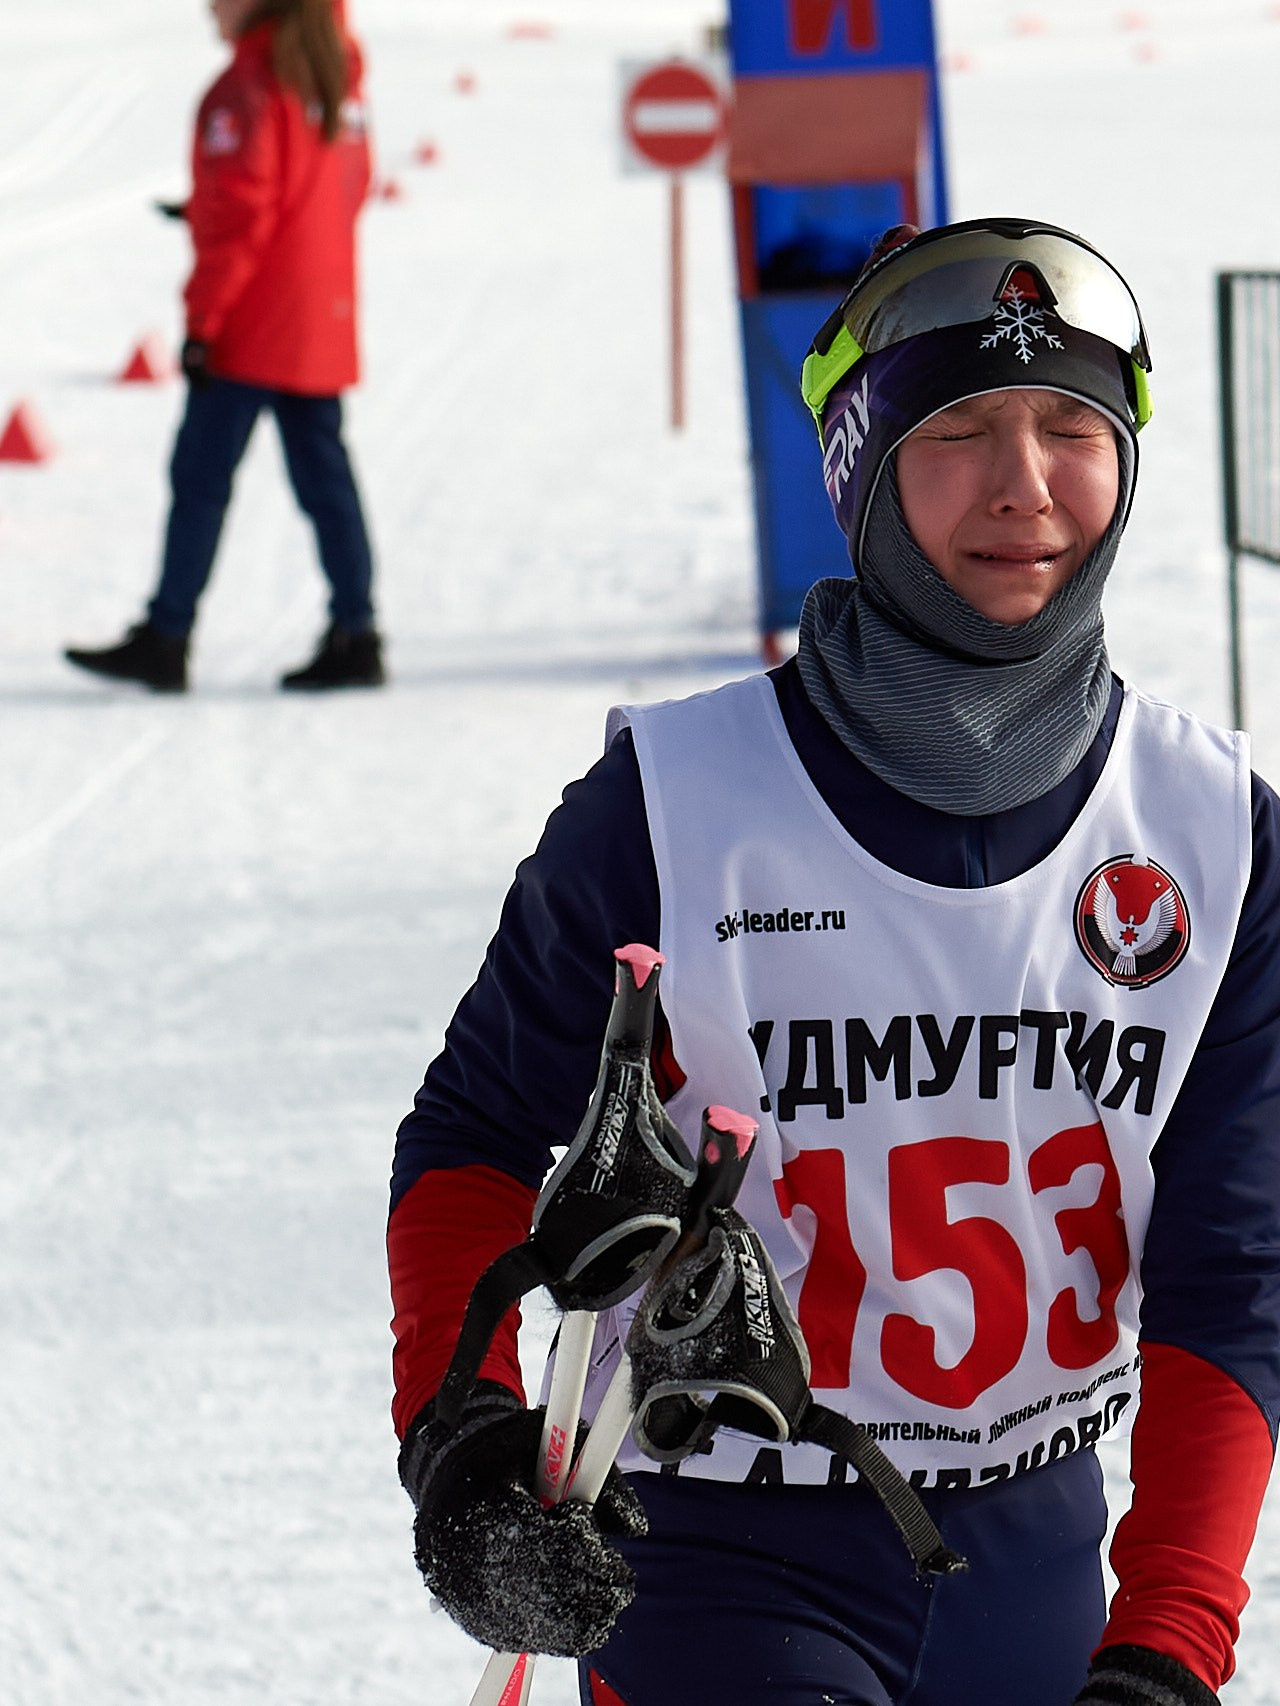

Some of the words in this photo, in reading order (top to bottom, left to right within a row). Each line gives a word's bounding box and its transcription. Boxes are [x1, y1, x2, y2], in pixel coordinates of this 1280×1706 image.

[595, 1092, 617, 1148] EVOLUTION
[773, 1122, 1130, 1410] 153
[761, 1275, 774, 1336] EVOLUTION
[987, 1394, 1053, 1444] лыжный
